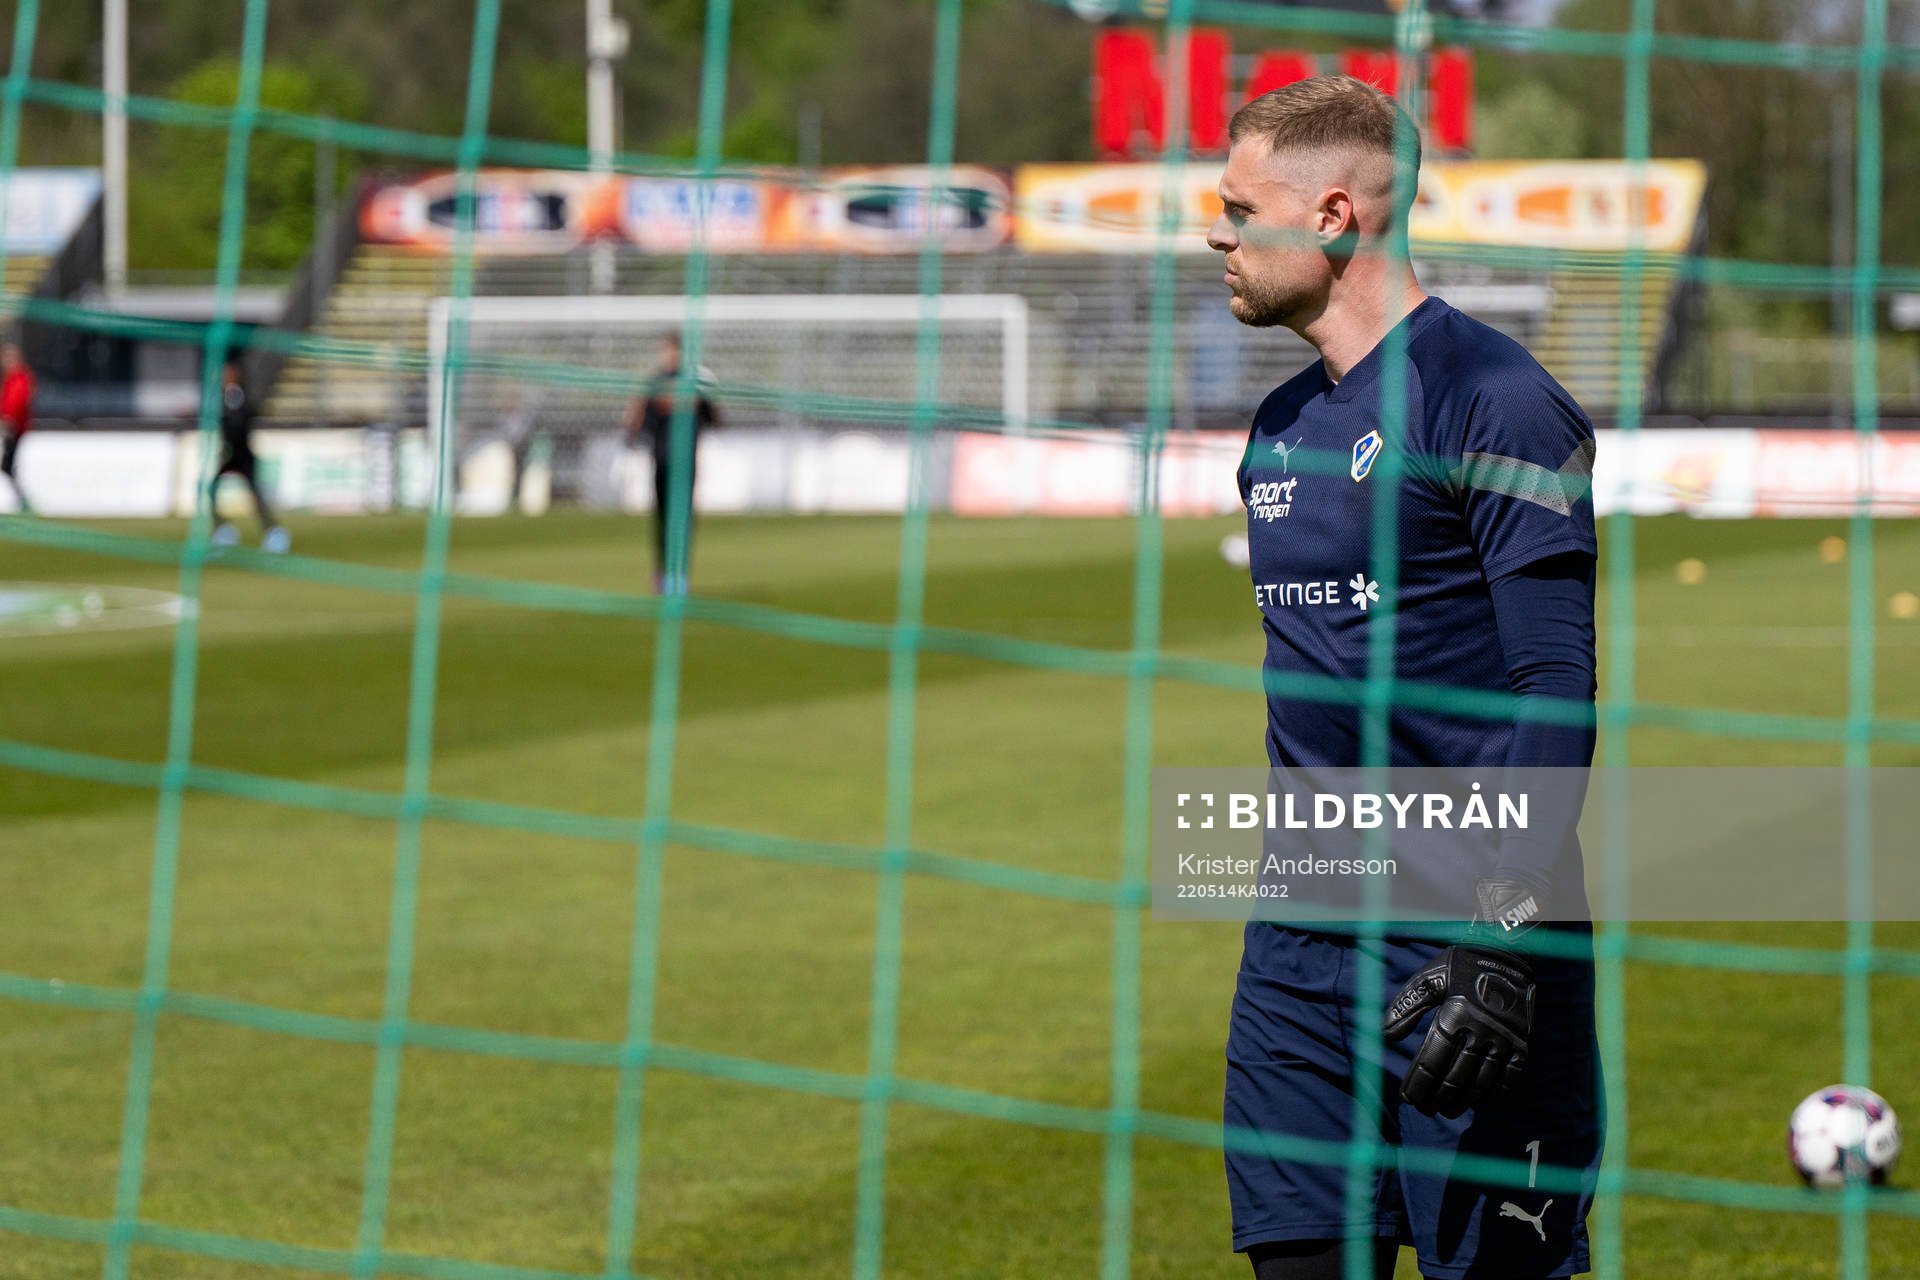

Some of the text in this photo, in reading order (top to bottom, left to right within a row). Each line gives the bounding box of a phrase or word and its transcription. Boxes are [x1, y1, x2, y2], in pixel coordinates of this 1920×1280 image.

[1250, 477, 1297, 511] sport
[1253, 504, 1290, 522] ringen
[1255, 581, 1340, 607] ETINGE
[1525, 1140, 1540, 1187] 1
